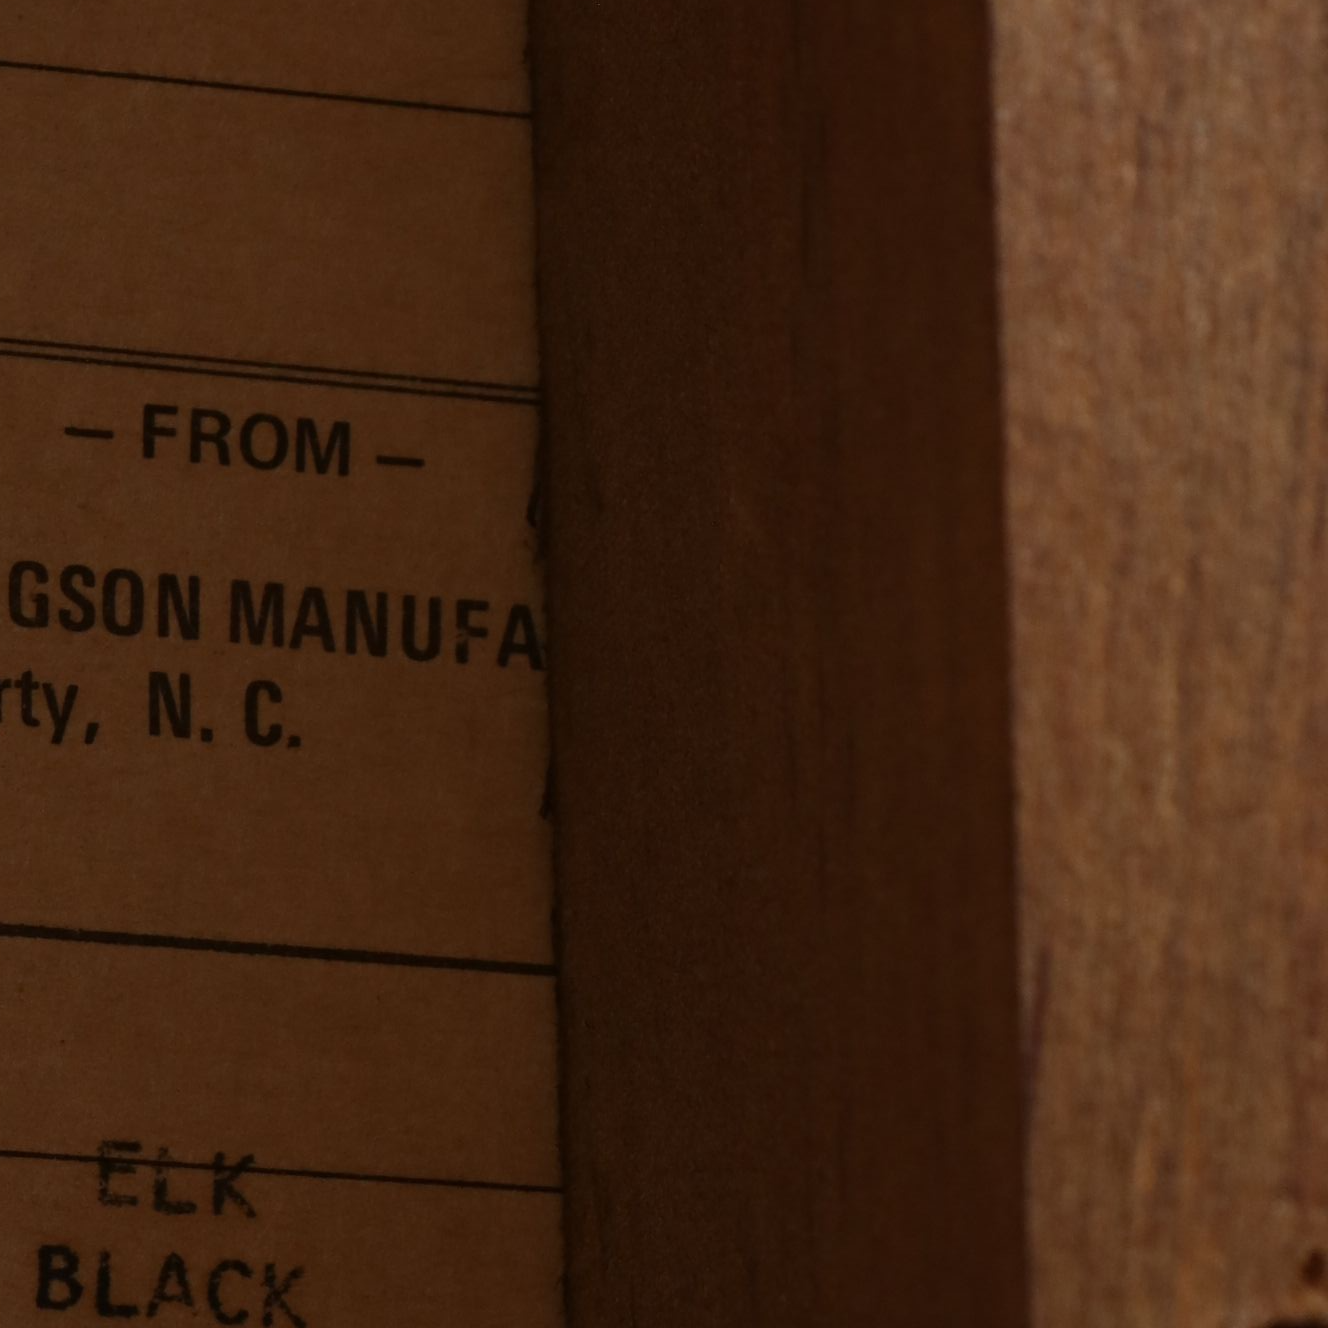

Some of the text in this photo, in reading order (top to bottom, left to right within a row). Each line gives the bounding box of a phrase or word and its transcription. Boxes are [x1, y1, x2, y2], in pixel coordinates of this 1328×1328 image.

[142, 404, 351, 476] FROM
[229, 580, 544, 671] MANUFA
[148, 672, 214, 742] N.
[245, 680, 302, 748] C.
[97, 1140, 257, 1218] ELK
